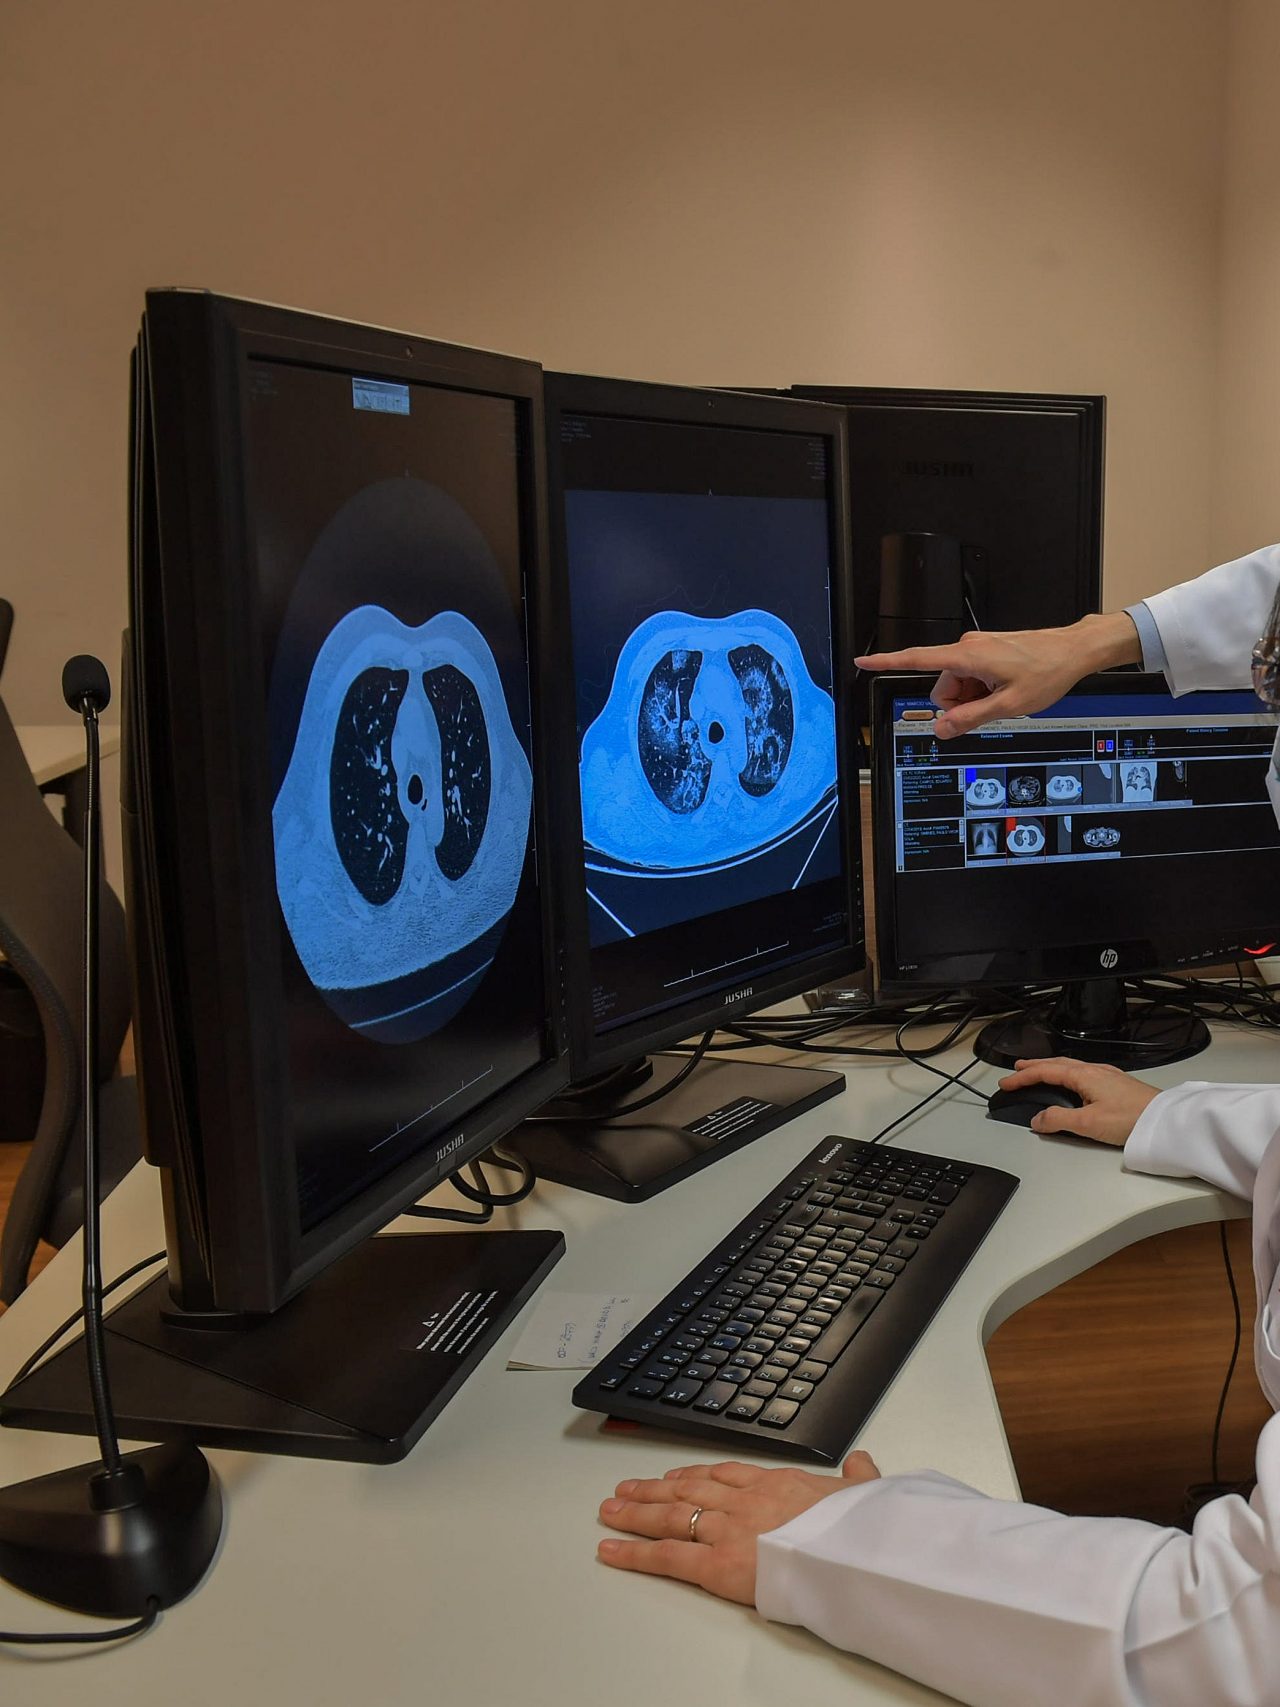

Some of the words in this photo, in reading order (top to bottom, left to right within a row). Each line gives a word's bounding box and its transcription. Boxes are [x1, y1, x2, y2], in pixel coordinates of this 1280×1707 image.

[724, 987, 753, 1005] JUSHA
[435, 1133, 464, 1163] JUSHA
[818, 1143, 842, 1164] lenovo
